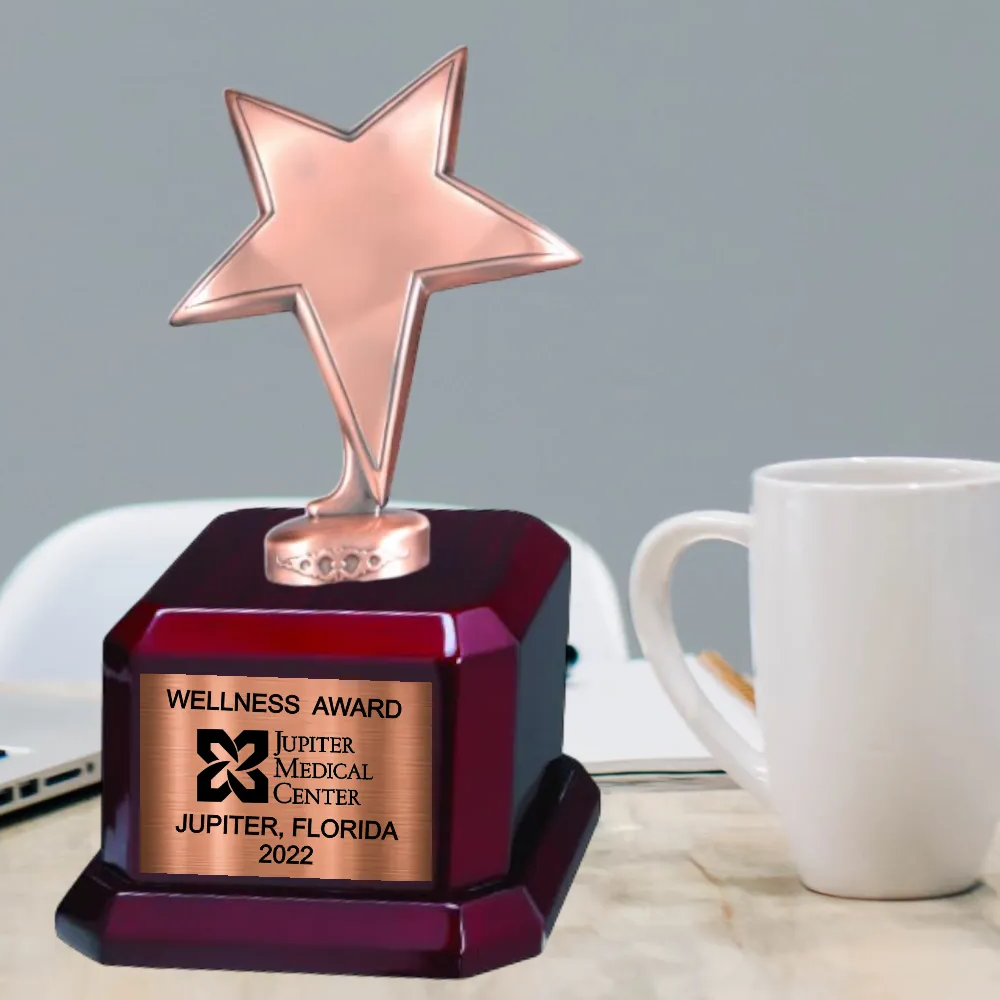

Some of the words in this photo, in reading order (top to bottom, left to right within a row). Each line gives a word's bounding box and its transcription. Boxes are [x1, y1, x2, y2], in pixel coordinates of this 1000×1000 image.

[166, 688, 300, 715] WELLNESS
[311, 695, 403, 719] AWARD
[272, 730, 356, 757] JUPITER
[273, 757, 374, 781] MEDICAL
[272, 781, 362, 806] CENTER
[175, 813, 284, 840] JUPITER,
[292, 817, 399, 841] FLORIDA
[258, 843, 314, 866] 2022
